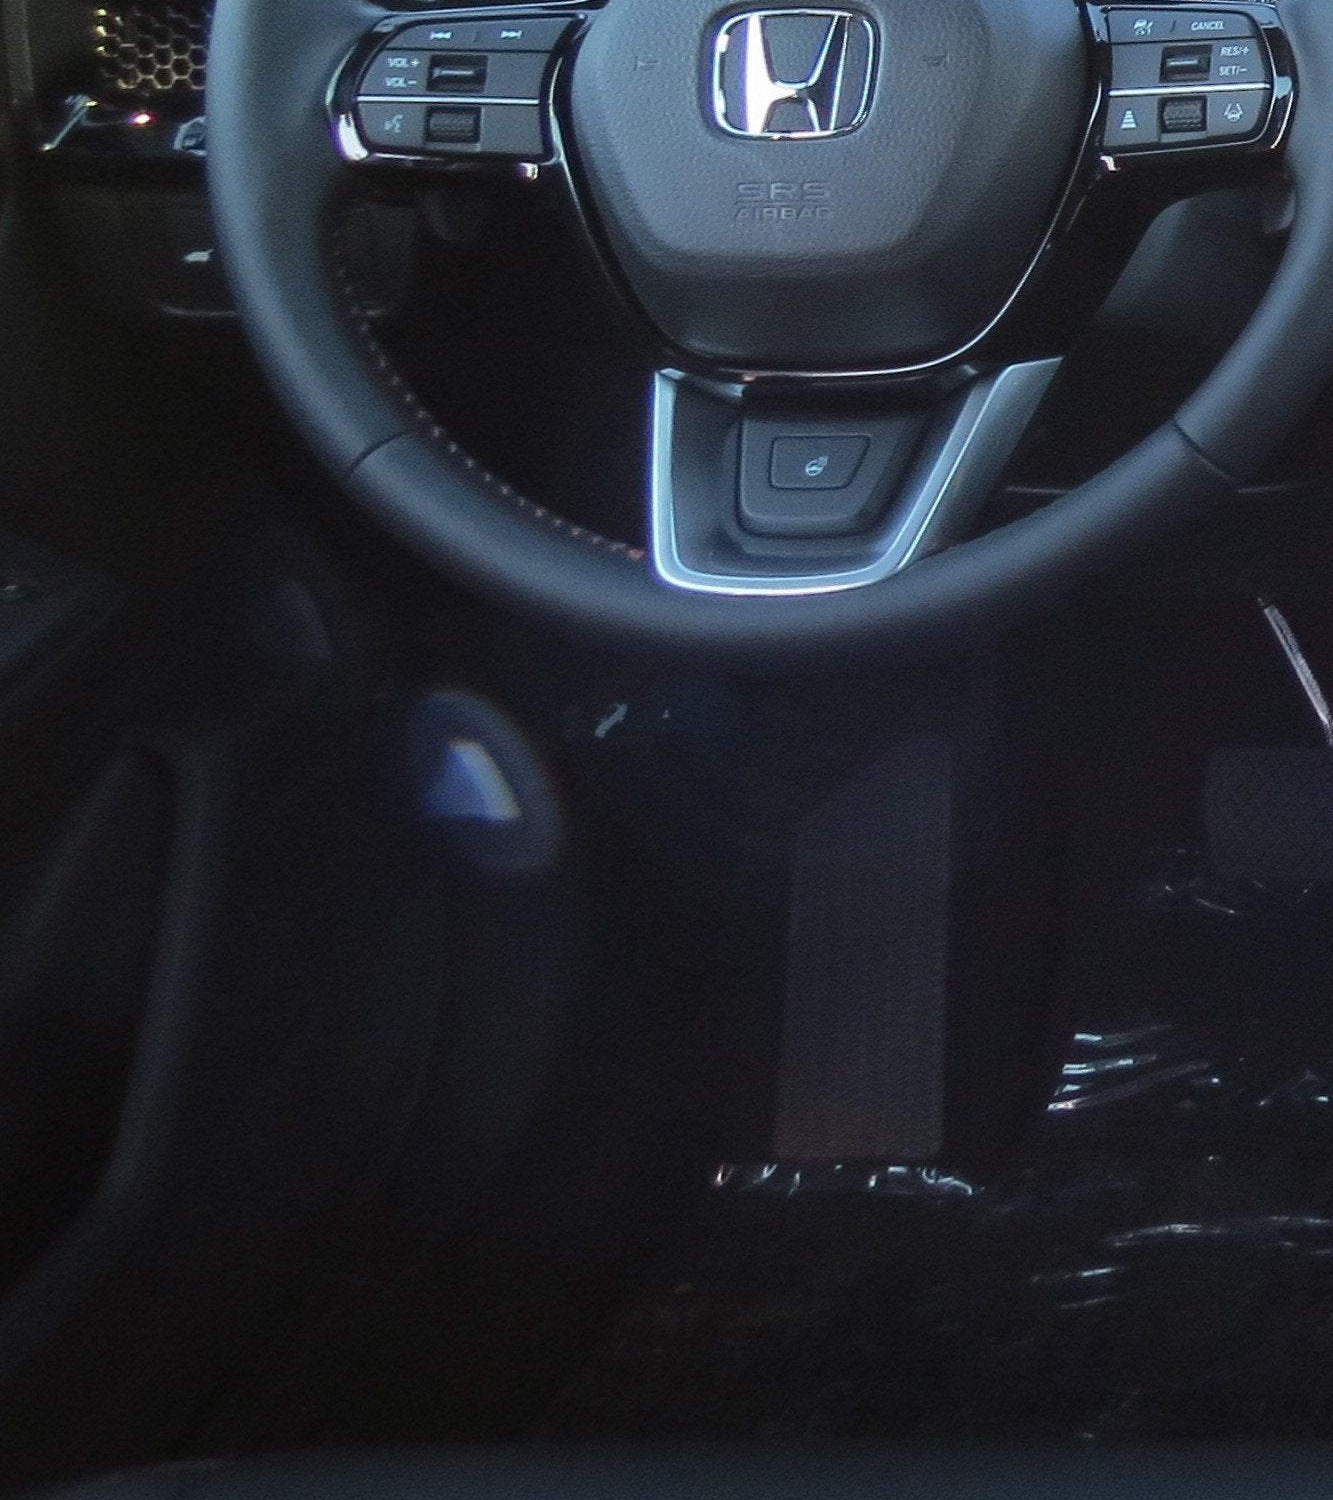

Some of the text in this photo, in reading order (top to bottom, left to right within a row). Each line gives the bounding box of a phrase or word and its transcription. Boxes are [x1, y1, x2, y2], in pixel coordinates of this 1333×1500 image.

[1190, 20, 1225, 31] CANCEL
[1220, 45, 1250, 56] RES/+
[736, 181, 831, 202] SRS
[734, 205, 833, 221] AIRBAG
